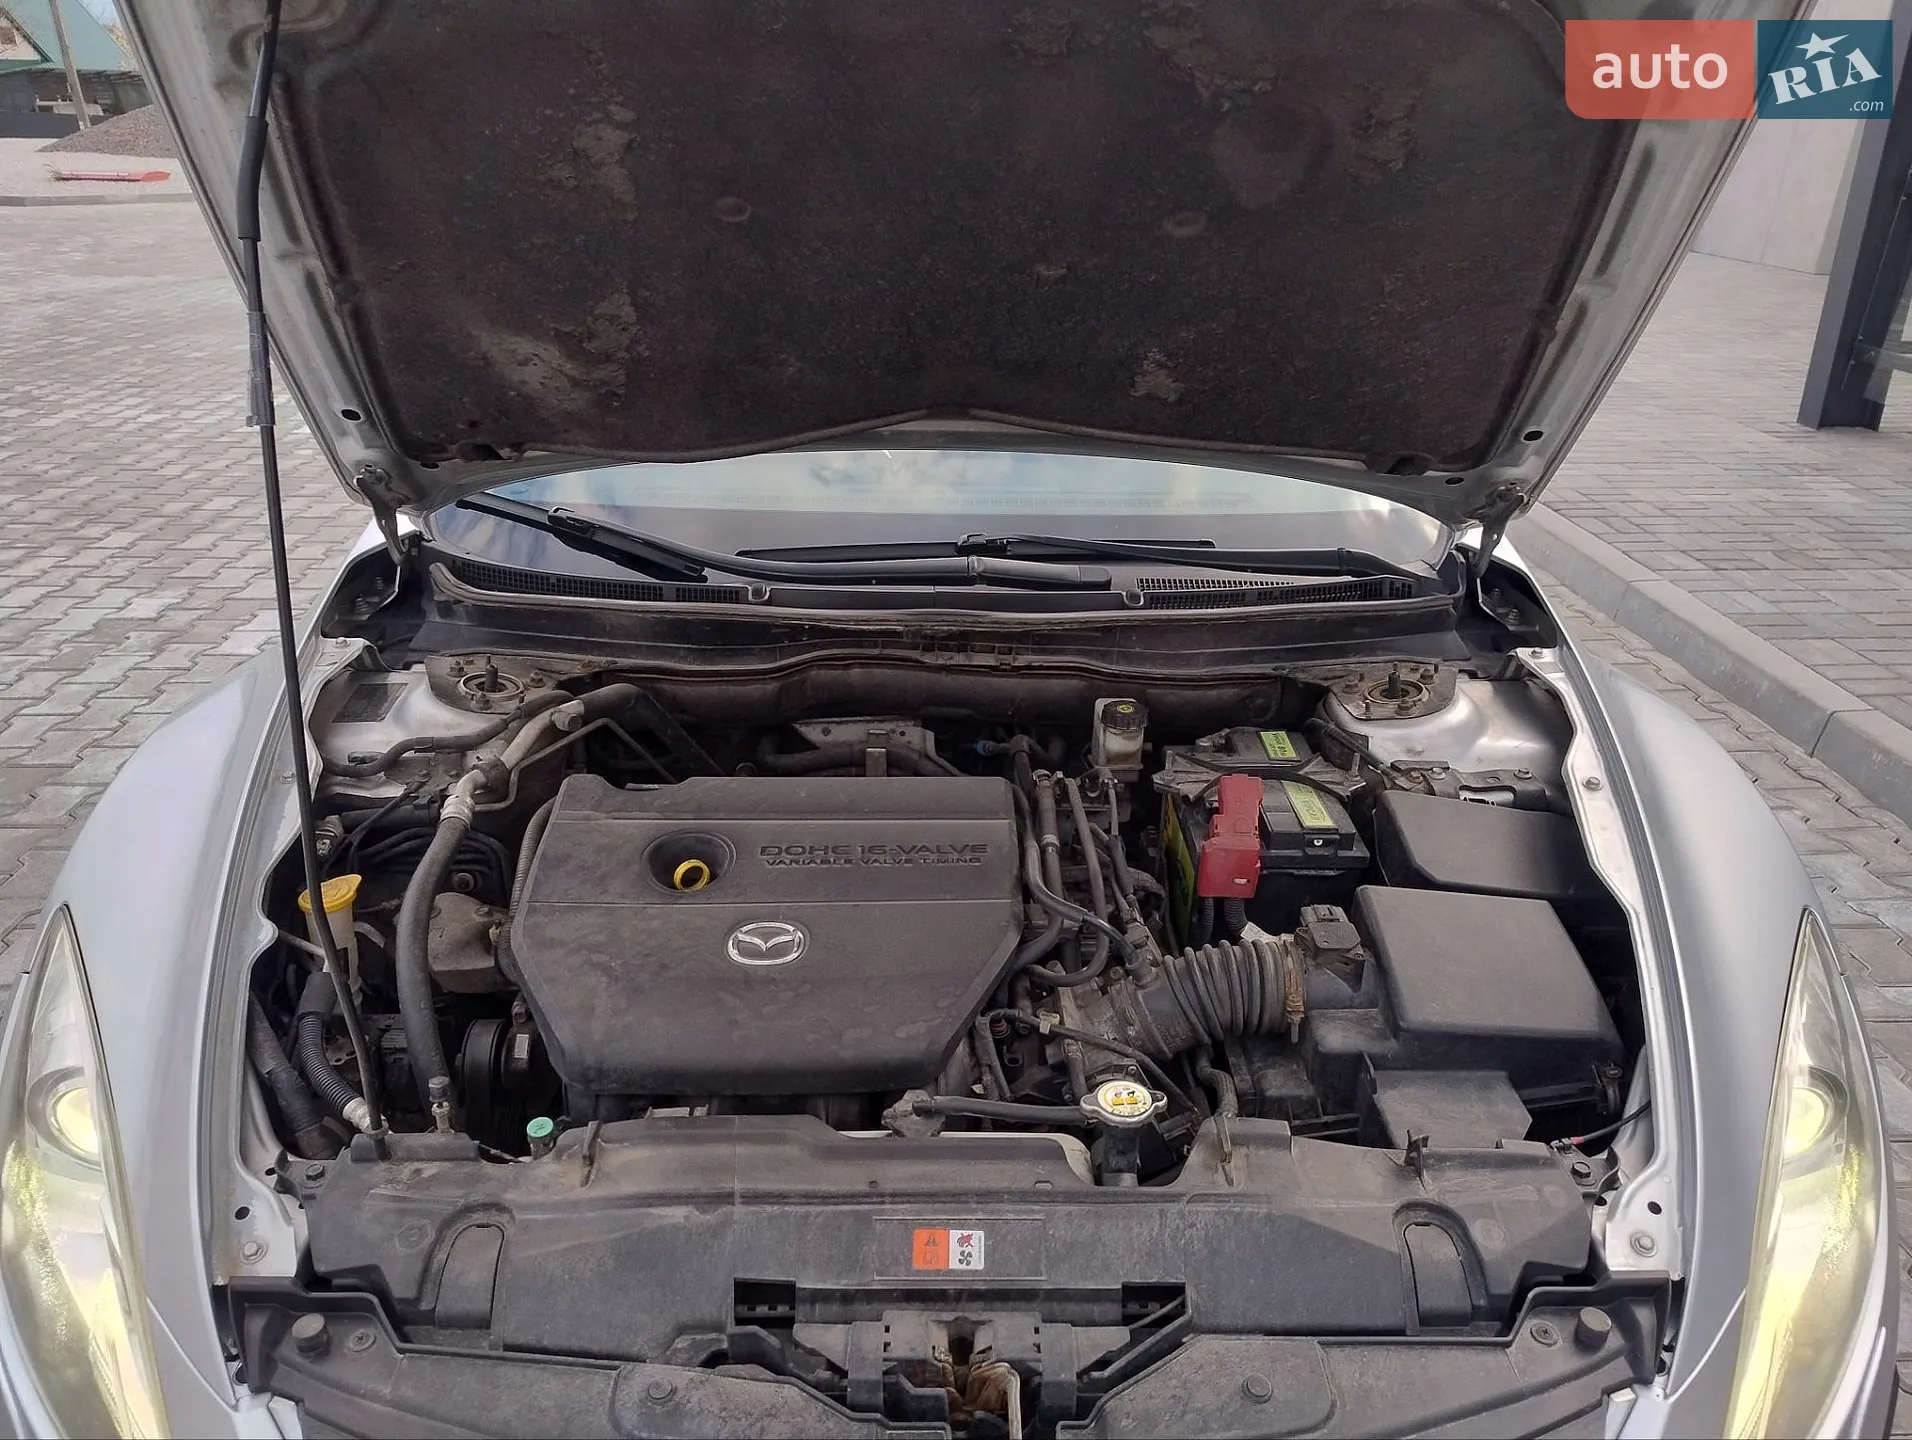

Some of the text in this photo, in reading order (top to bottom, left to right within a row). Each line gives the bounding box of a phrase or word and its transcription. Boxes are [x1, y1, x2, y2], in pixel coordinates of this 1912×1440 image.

[759, 843, 989, 857] DOHC 16-VALVE
[765, 856, 982, 867] VARIABLE VALVE TIMING
